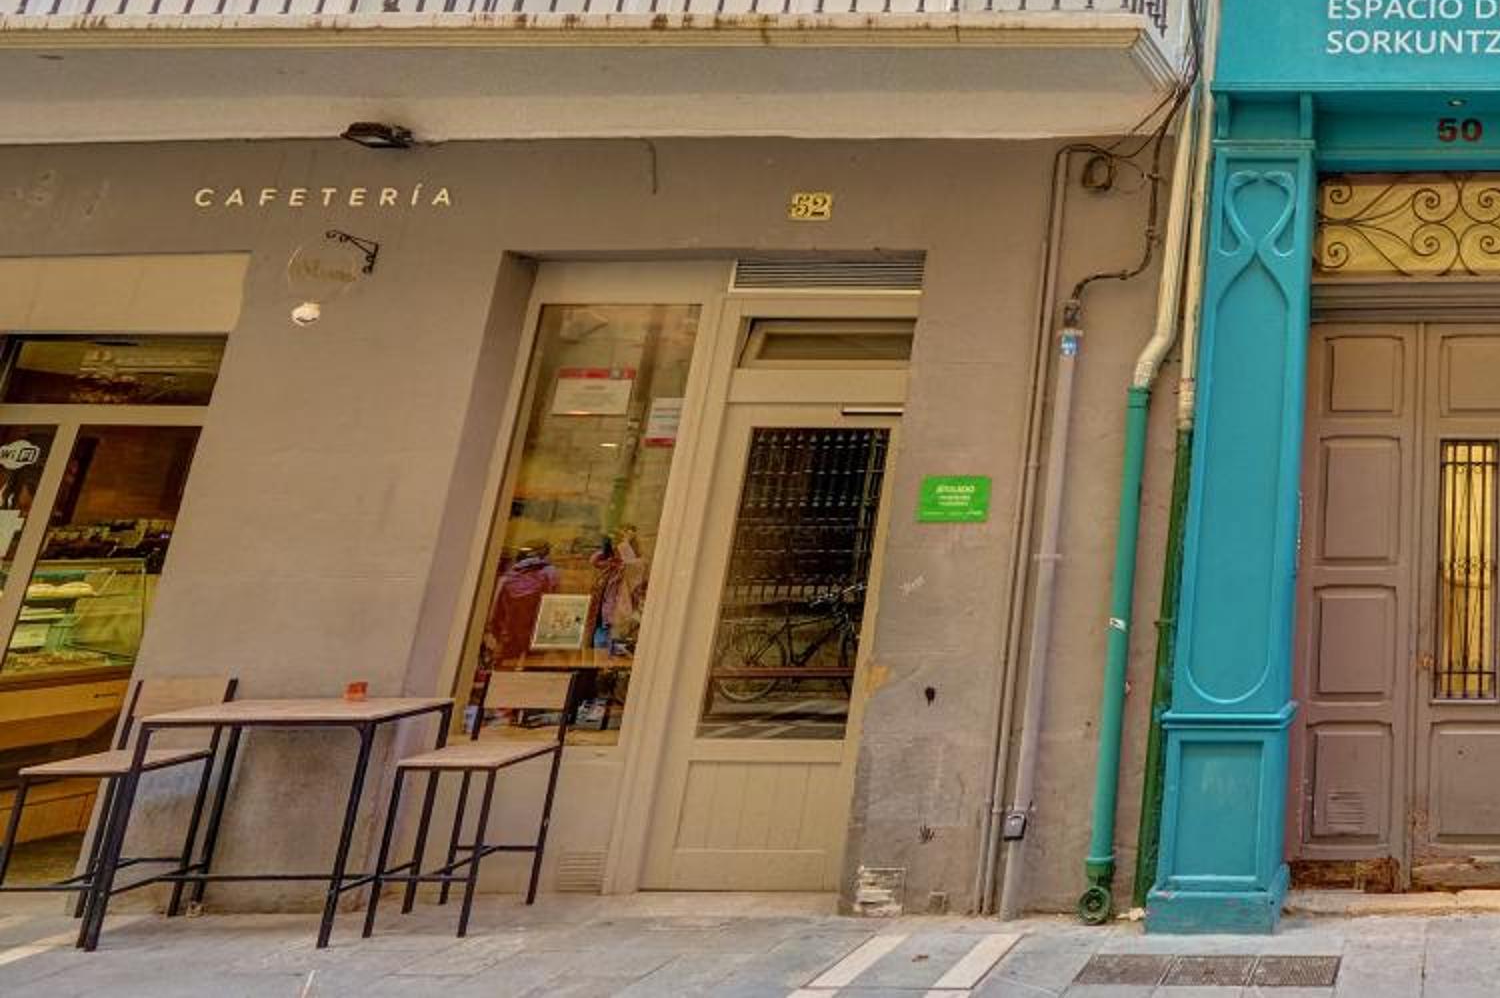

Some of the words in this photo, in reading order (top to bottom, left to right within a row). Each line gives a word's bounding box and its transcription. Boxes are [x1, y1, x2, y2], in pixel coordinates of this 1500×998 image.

[1437, 117, 1483, 142] 50
[194, 182, 451, 208] CAFETERÍA
[795, 193, 827, 218] 52
